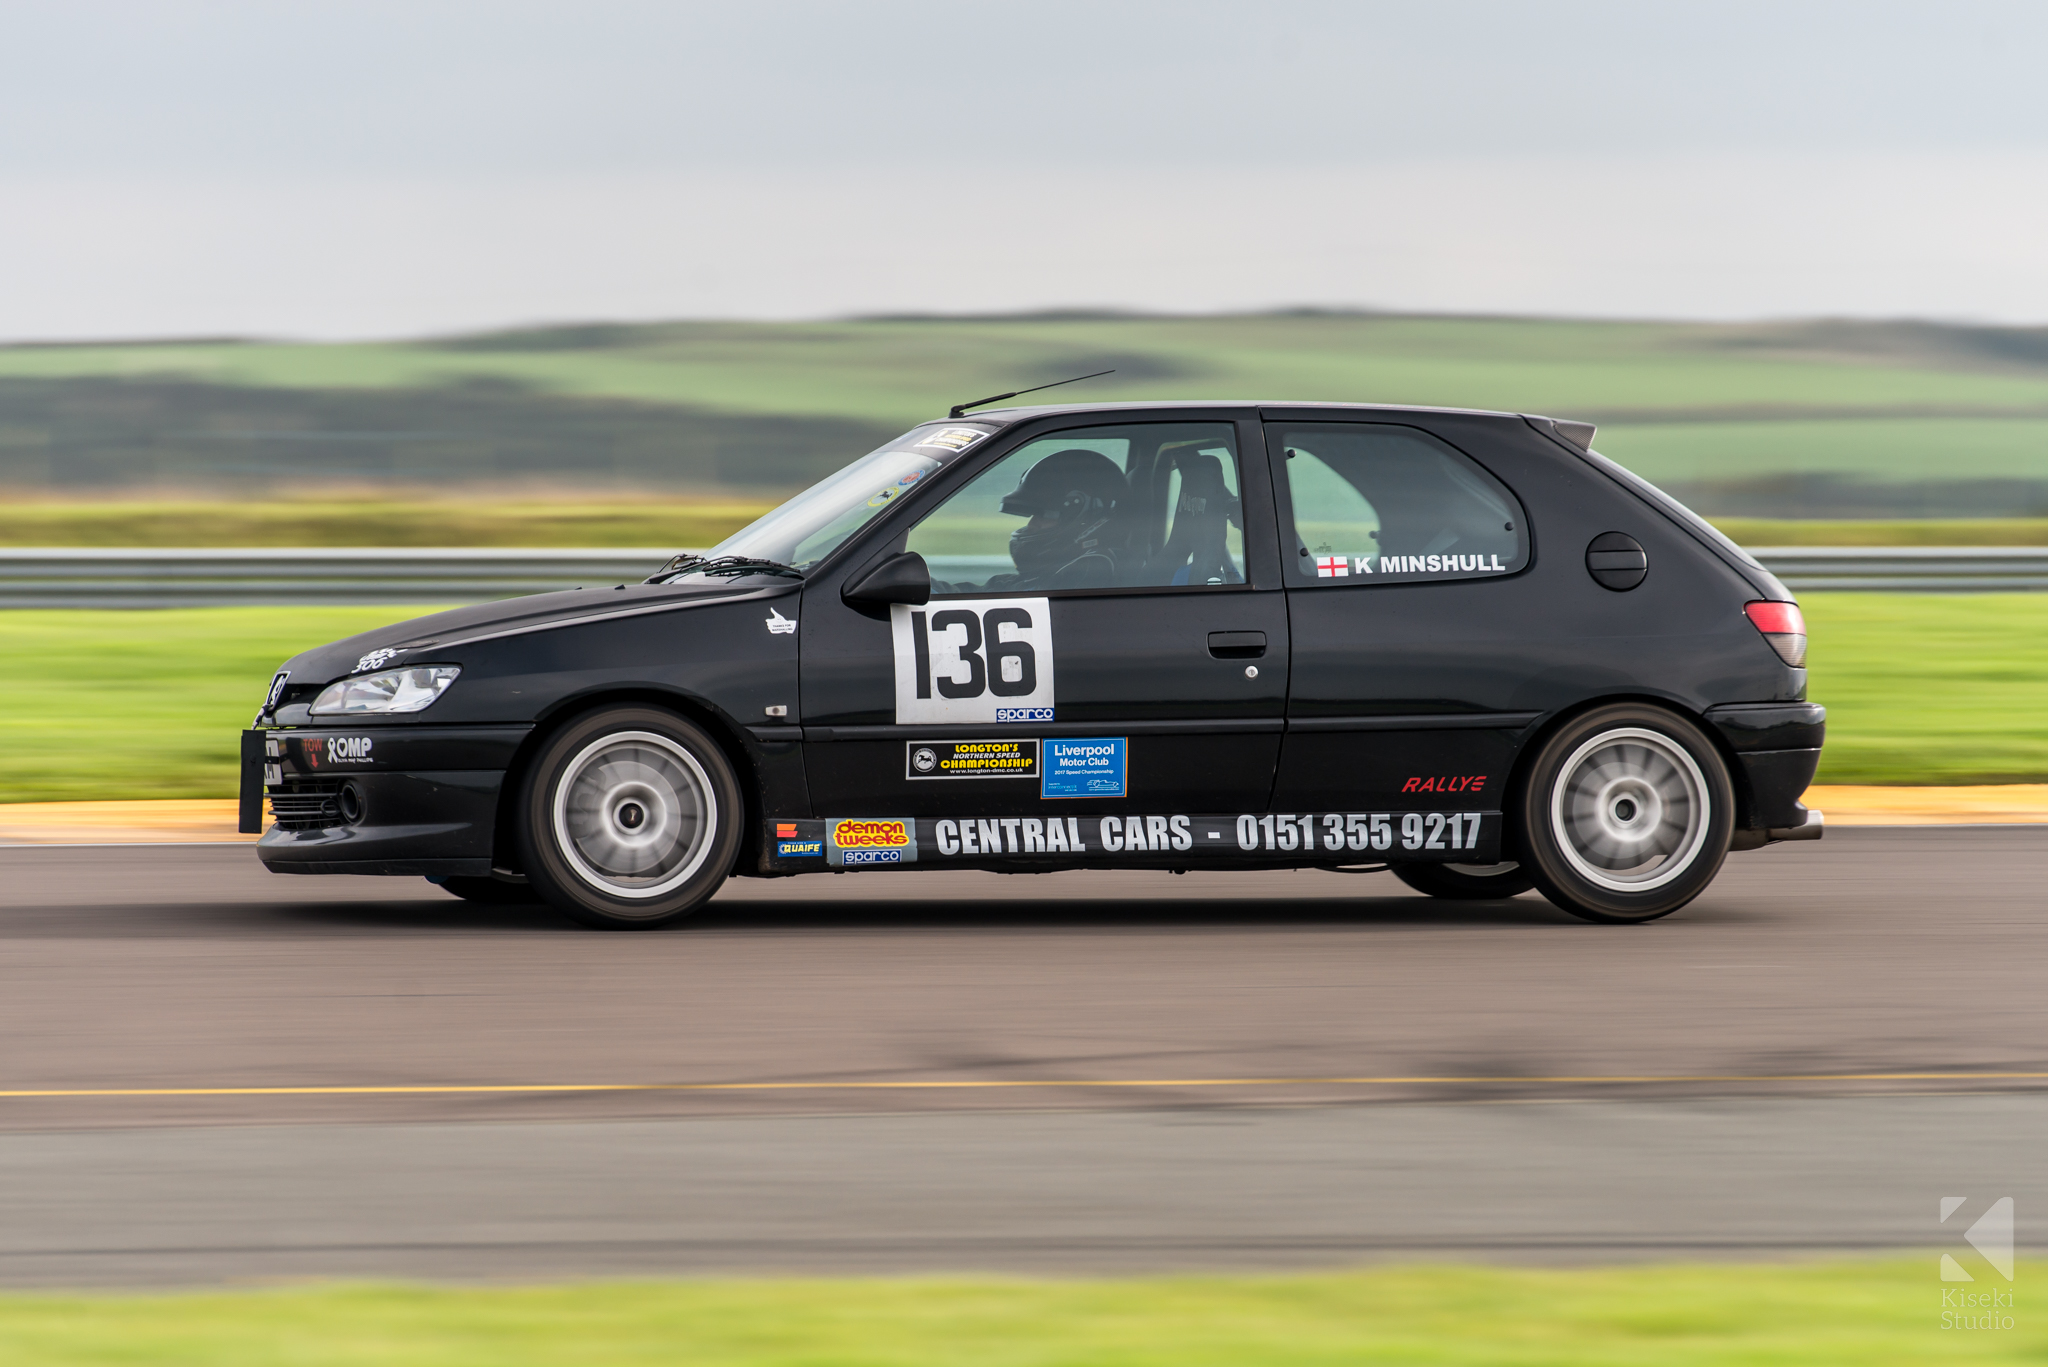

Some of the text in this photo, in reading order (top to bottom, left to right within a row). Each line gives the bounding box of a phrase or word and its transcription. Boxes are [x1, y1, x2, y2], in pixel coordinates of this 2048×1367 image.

[1355, 554, 1506, 574] K MINSHULL
[911, 608, 1037, 699] 136
[998, 709, 1053, 720] sparco
[303, 738, 322, 751] TOW
[955, 744, 1019, 753] LONGTON'S
[1054, 743, 1115, 757] Liverpool
[940, 758, 1033, 769] CHAMPIONSHIP
[1060, 757, 1109, 767] Motor Club
[1401, 776, 1487, 793] RALLYE
[837, 820, 903, 834] demon
[935, 817, 1086, 855] CENTRAL
[1100, 815, 1193, 852] CARS
[1236, 814, 1315, 852] 0151
[1322, 814, 1392, 850] 355
[1401, 812, 1483, 850] 9217
[835, 832, 908, 846] tweeks
[783, 843, 820, 854] QUAIFE
[845, 852, 899, 864] sparco
